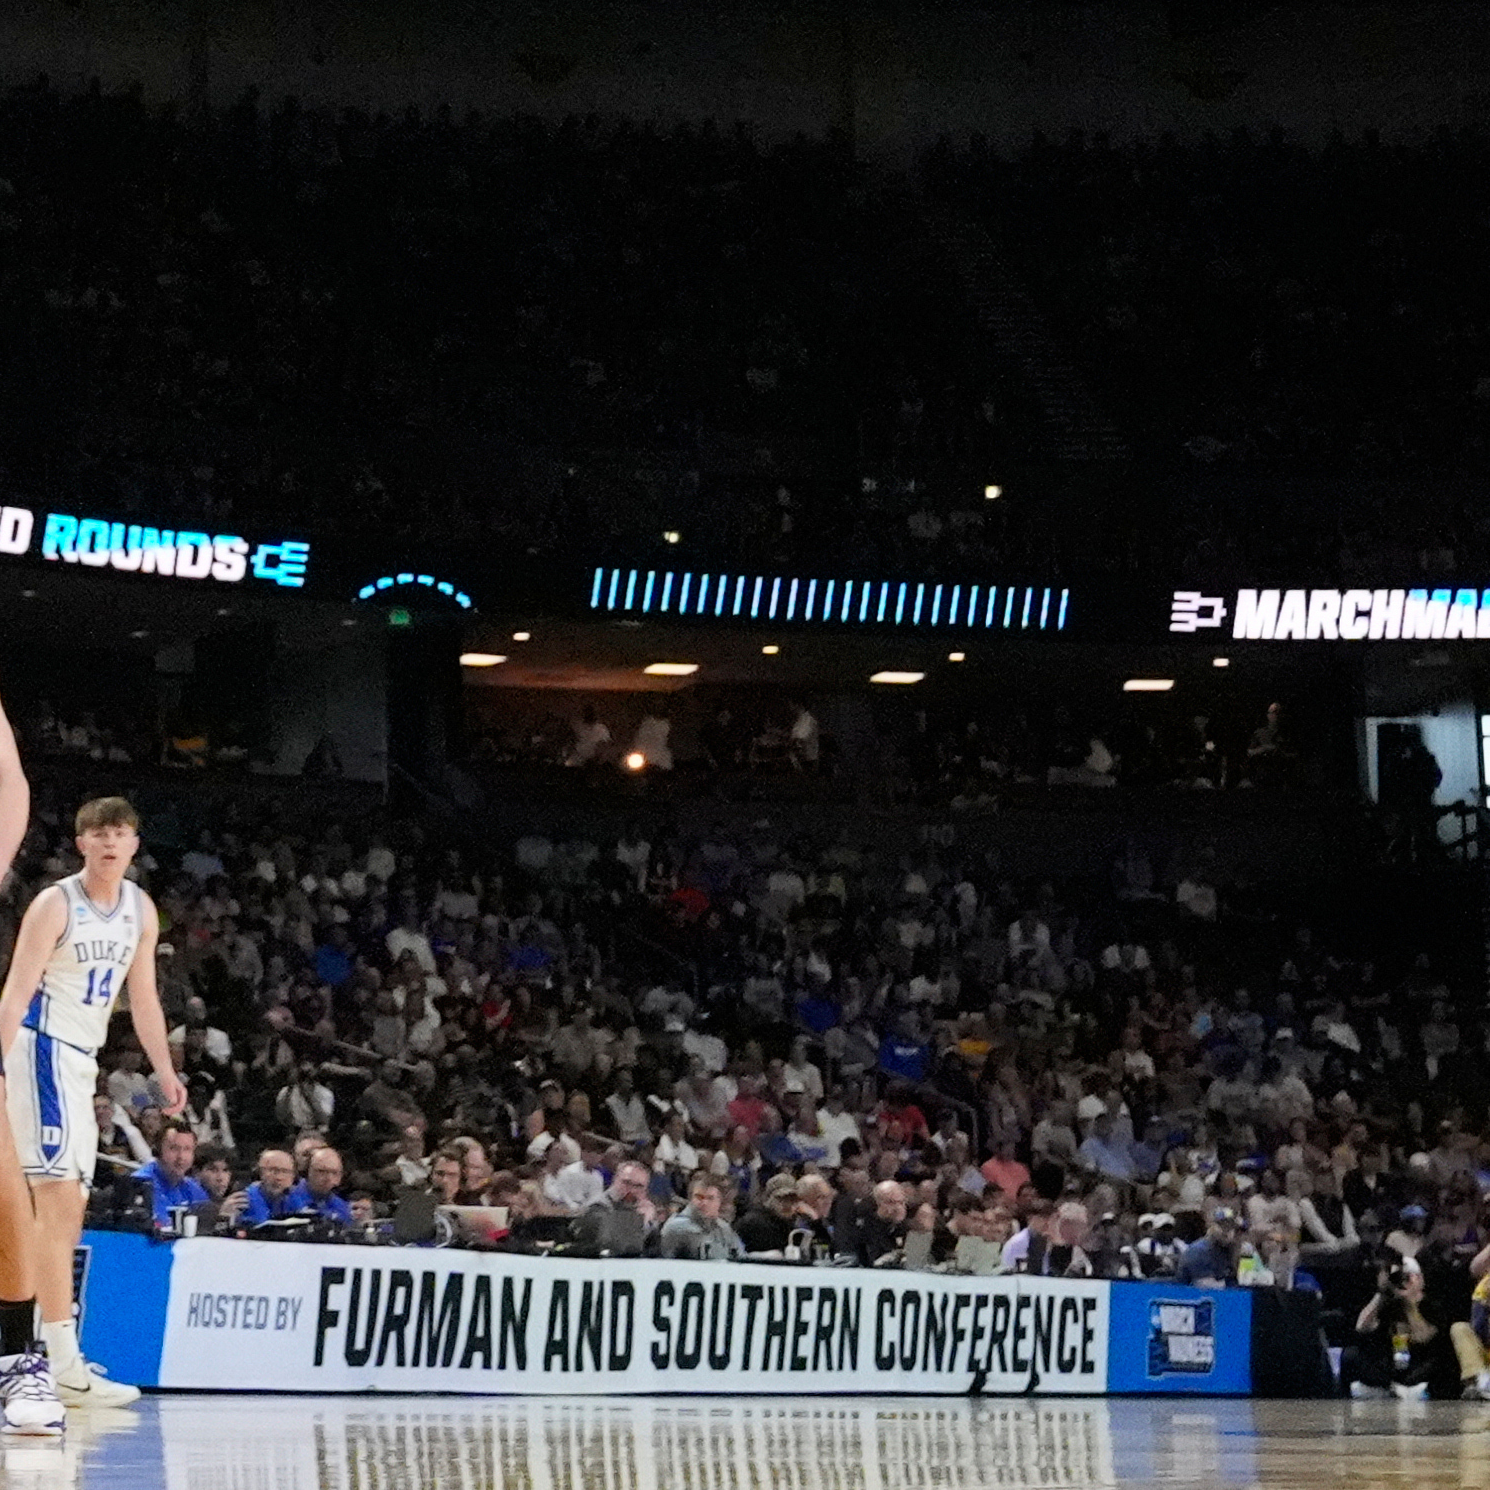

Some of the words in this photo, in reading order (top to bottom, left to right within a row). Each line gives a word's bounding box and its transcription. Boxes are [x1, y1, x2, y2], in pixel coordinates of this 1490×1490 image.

[42, 513, 249, 582] ROUNDS
[74, 940, 131, 966] DUKE
[82, 967, 114, 1007] 14
[187, 1292, 268, 1331] HOSTED
[274, 1296, 304, 1331] BY
[313, 1266, 534, 1372] FURMAN
[543, 1279, 636, 1373] AND
[650, 1279, 862, 1373] SOUTHERN
[874, 1288, 1098, 1375] CONFERENCE
